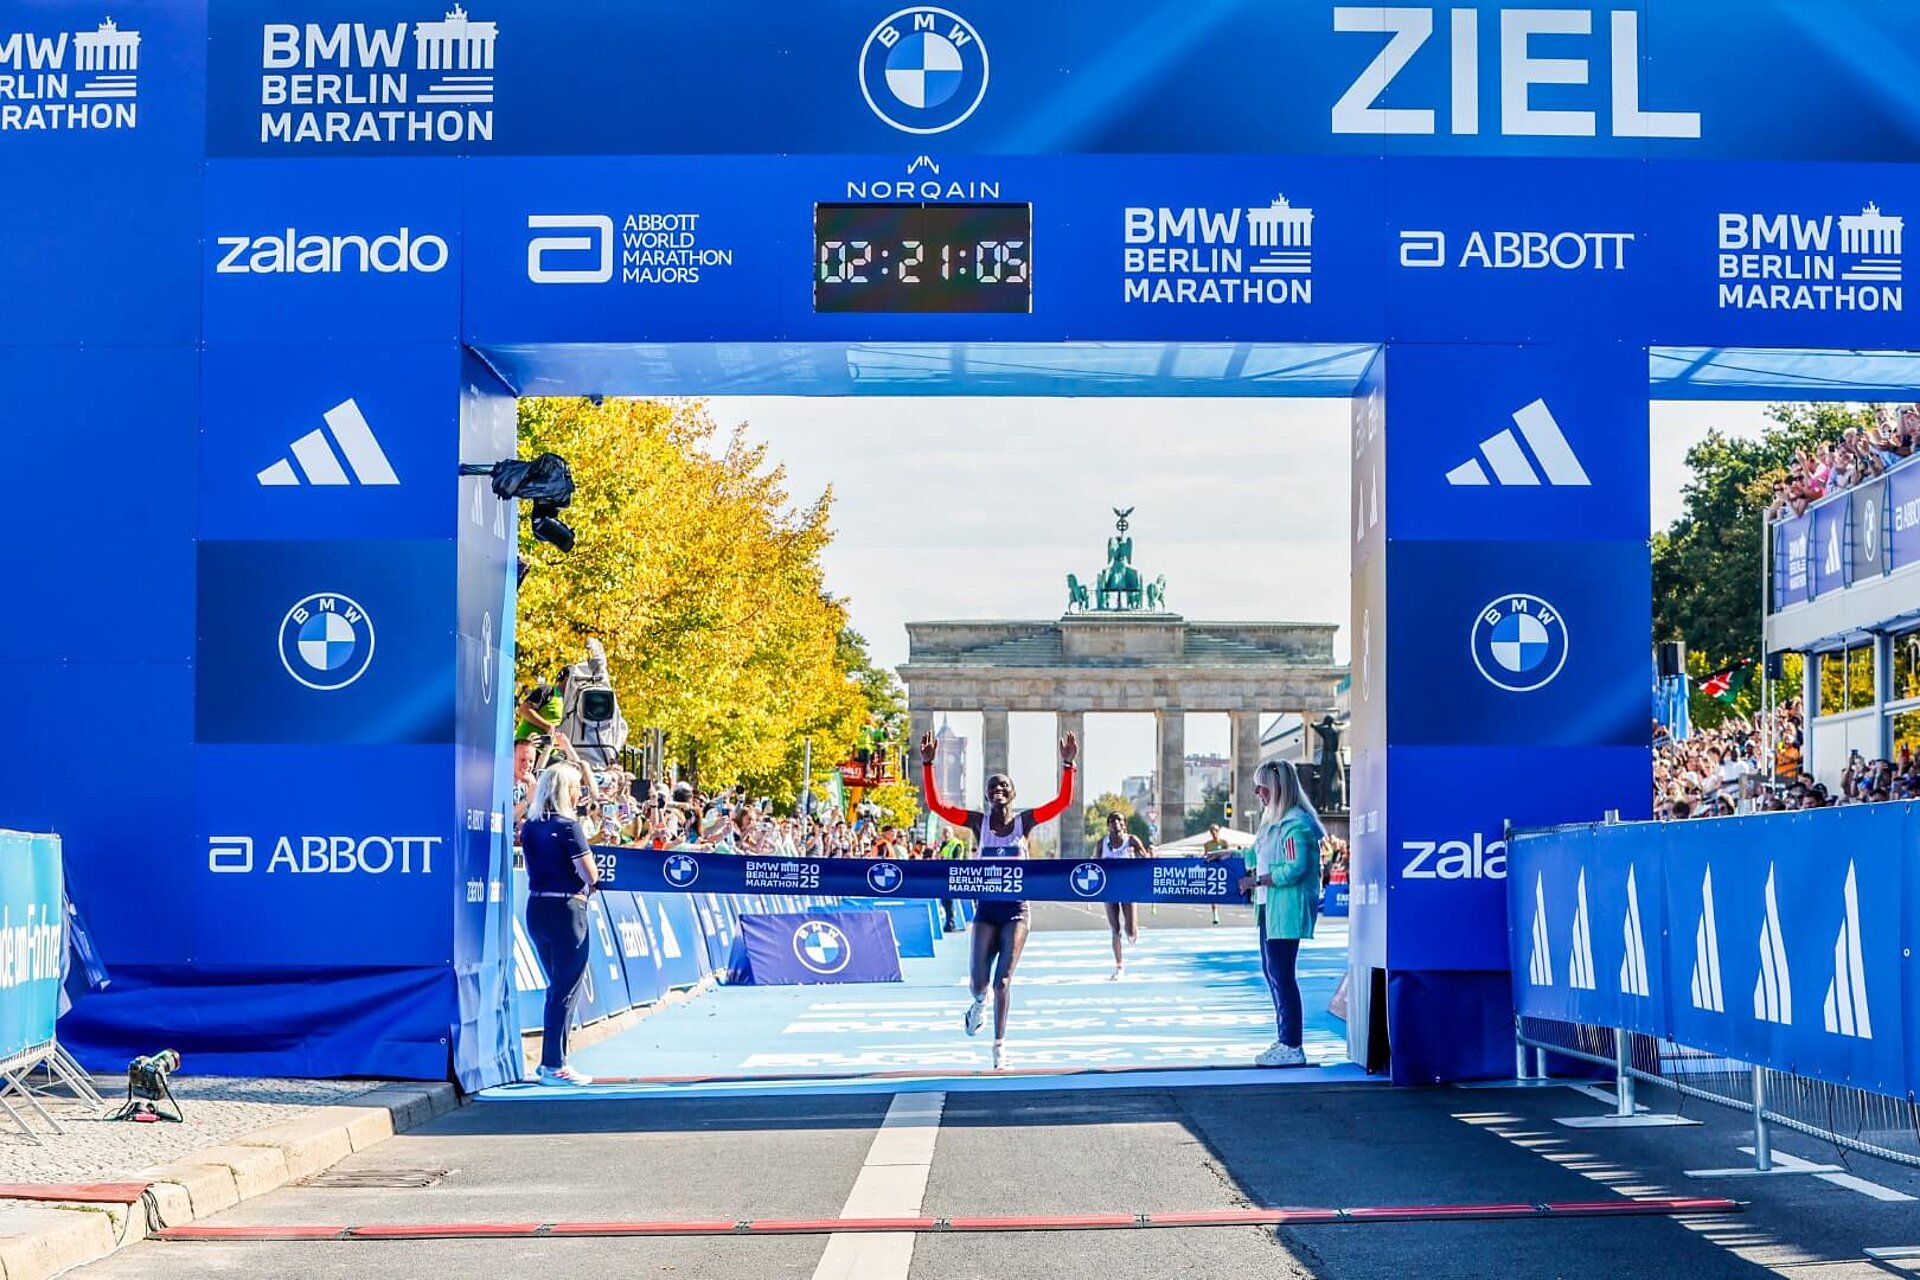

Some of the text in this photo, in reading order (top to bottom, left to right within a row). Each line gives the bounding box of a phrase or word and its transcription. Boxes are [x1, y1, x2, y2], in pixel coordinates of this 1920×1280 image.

[877, 13, 972, 48] BMW
[0, 32, 68, 70] MW
[262, 22, 407, 69] BMW
[1331, 6, 1701, 138] ZIEL
[0, 74, 68, 99] RLIN
[262, 73, 407, 105] BERLIN
[2, 103, 136, 130] RATHON
[261, 110, 493, 143] MARATHON
[847, 181, 1000, 200] NORQAIN
[623, 214, 700, 231] ABBOTT
[1124, 207, 1241, 244] BMW
[1718, 213, 1833, 251] BMW
[622, 232, 695, 249] WORLD
[216, 227, 449, 274] zalando
[623, 250, 732, 266] MARATHON
[1459, 231, 1635, 270] ABBOTT
[820, 240, 1027, 284] 02:21:05
[1124, 248, 1242, 273] BERLIN
[1718, 254, 1834, 280] BERLIN
[623, 267, 699, 283] MAJORS
[1124, 278, 1312, 304] MARATHON
[1718, 284, 1902, 311] MARATHON
[293, 598, 362, 625] BMW
[1484, 598, 1555, 626] BMW
[266, 836, 442, 874] ABBOTT
[597, 854, 617, 868] 20
[1402, 832, 1507, 879] zala
[597, 869, 616, 882] 25
[745, 861, 780, 871] BMW
[745, 871, 780, 880] BERLIN
[800, 863, 820, 875] 20
[949, 866, 983, 876] BMW
[1003, 867, 1023, 879] 20
[1153, 867, 1187, 878] BMW
[1207, 868, 1228, 881] 20
[745, 879, 799, 889] MARATHON
[800, 875, 820, 888] 25
[949, 876, 983, 884] BERLIN
[949, 884, 1002, 893] MARATHON
[1003, 880, 1023, 893] 25
[1153, 878, 1187, 887] BERLIN
[1207, 882, 1228, 895] 25
[1153, 886, 1207, 896] MARATHON
